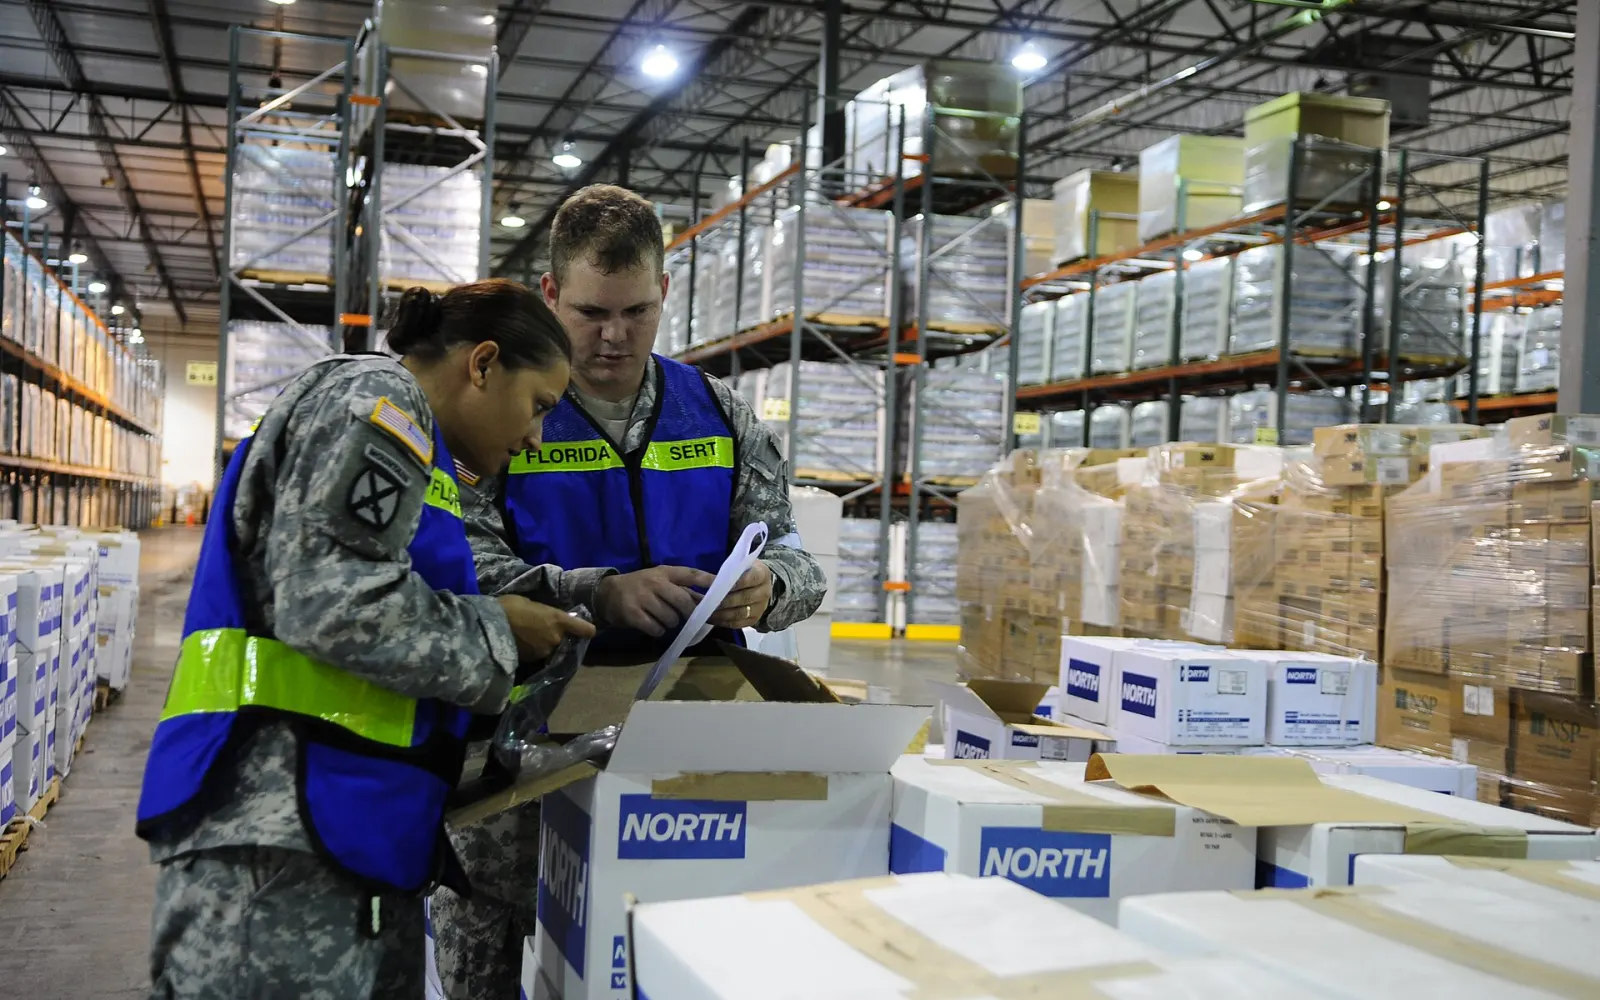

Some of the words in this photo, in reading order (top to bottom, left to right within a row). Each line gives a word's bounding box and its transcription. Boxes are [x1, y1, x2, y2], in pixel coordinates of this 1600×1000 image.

[525, 445, 611, 464] FLORIDA
[670, 441, 717, 461] SERT
[1068, 667, 1099, 692] NORTH
[1287, 671, 1316, 681] NORTH
[1122, 682, 1156, 707] NORTH
[622, 812, 743, 842] NORTH
[538, 822, 588, 928] NORTH
[983, 846, 1108, 879] NORTH
